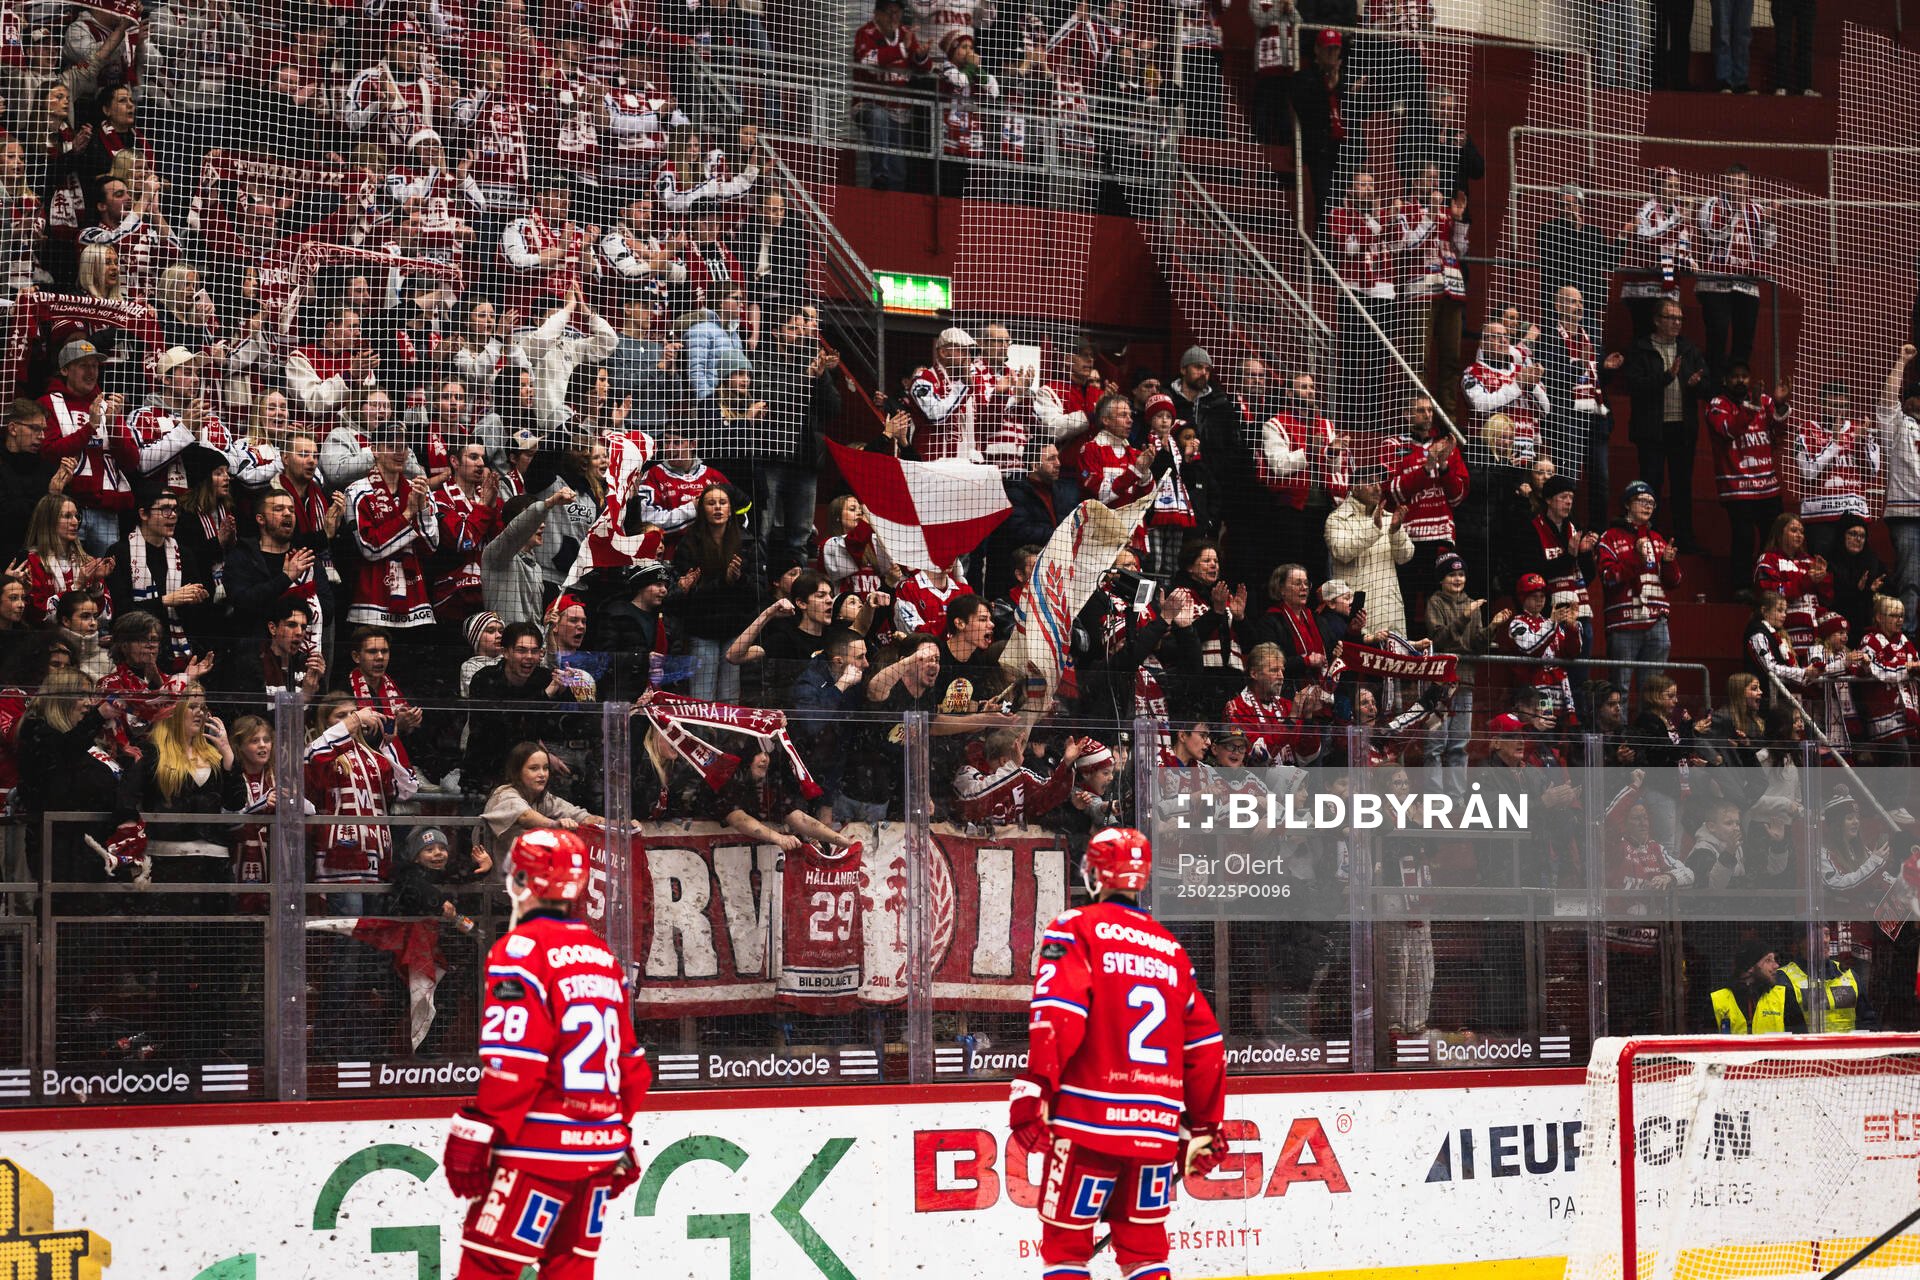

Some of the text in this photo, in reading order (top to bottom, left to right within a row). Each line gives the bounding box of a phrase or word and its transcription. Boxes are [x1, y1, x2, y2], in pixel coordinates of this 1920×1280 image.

[665, 698, 739, 724] TIMRÅ IK
[810, 891, 855, 942] 29
[1035, 963, 1057, 995] 2
[481, 1005, 529, 1043] 28
[1128, 984, 1168, 1066] 2
[560, 1003, 621, 1095] 28
[709, 1052, 831, 1078] Brandcode
[1436, 1038, 1533, 1061] Brandcode
[43, 1066, 191, 1096] Brandcode
[378, 1062, 485, 1085] brandco
[914, 1116, 1352, 1213] BOGA
